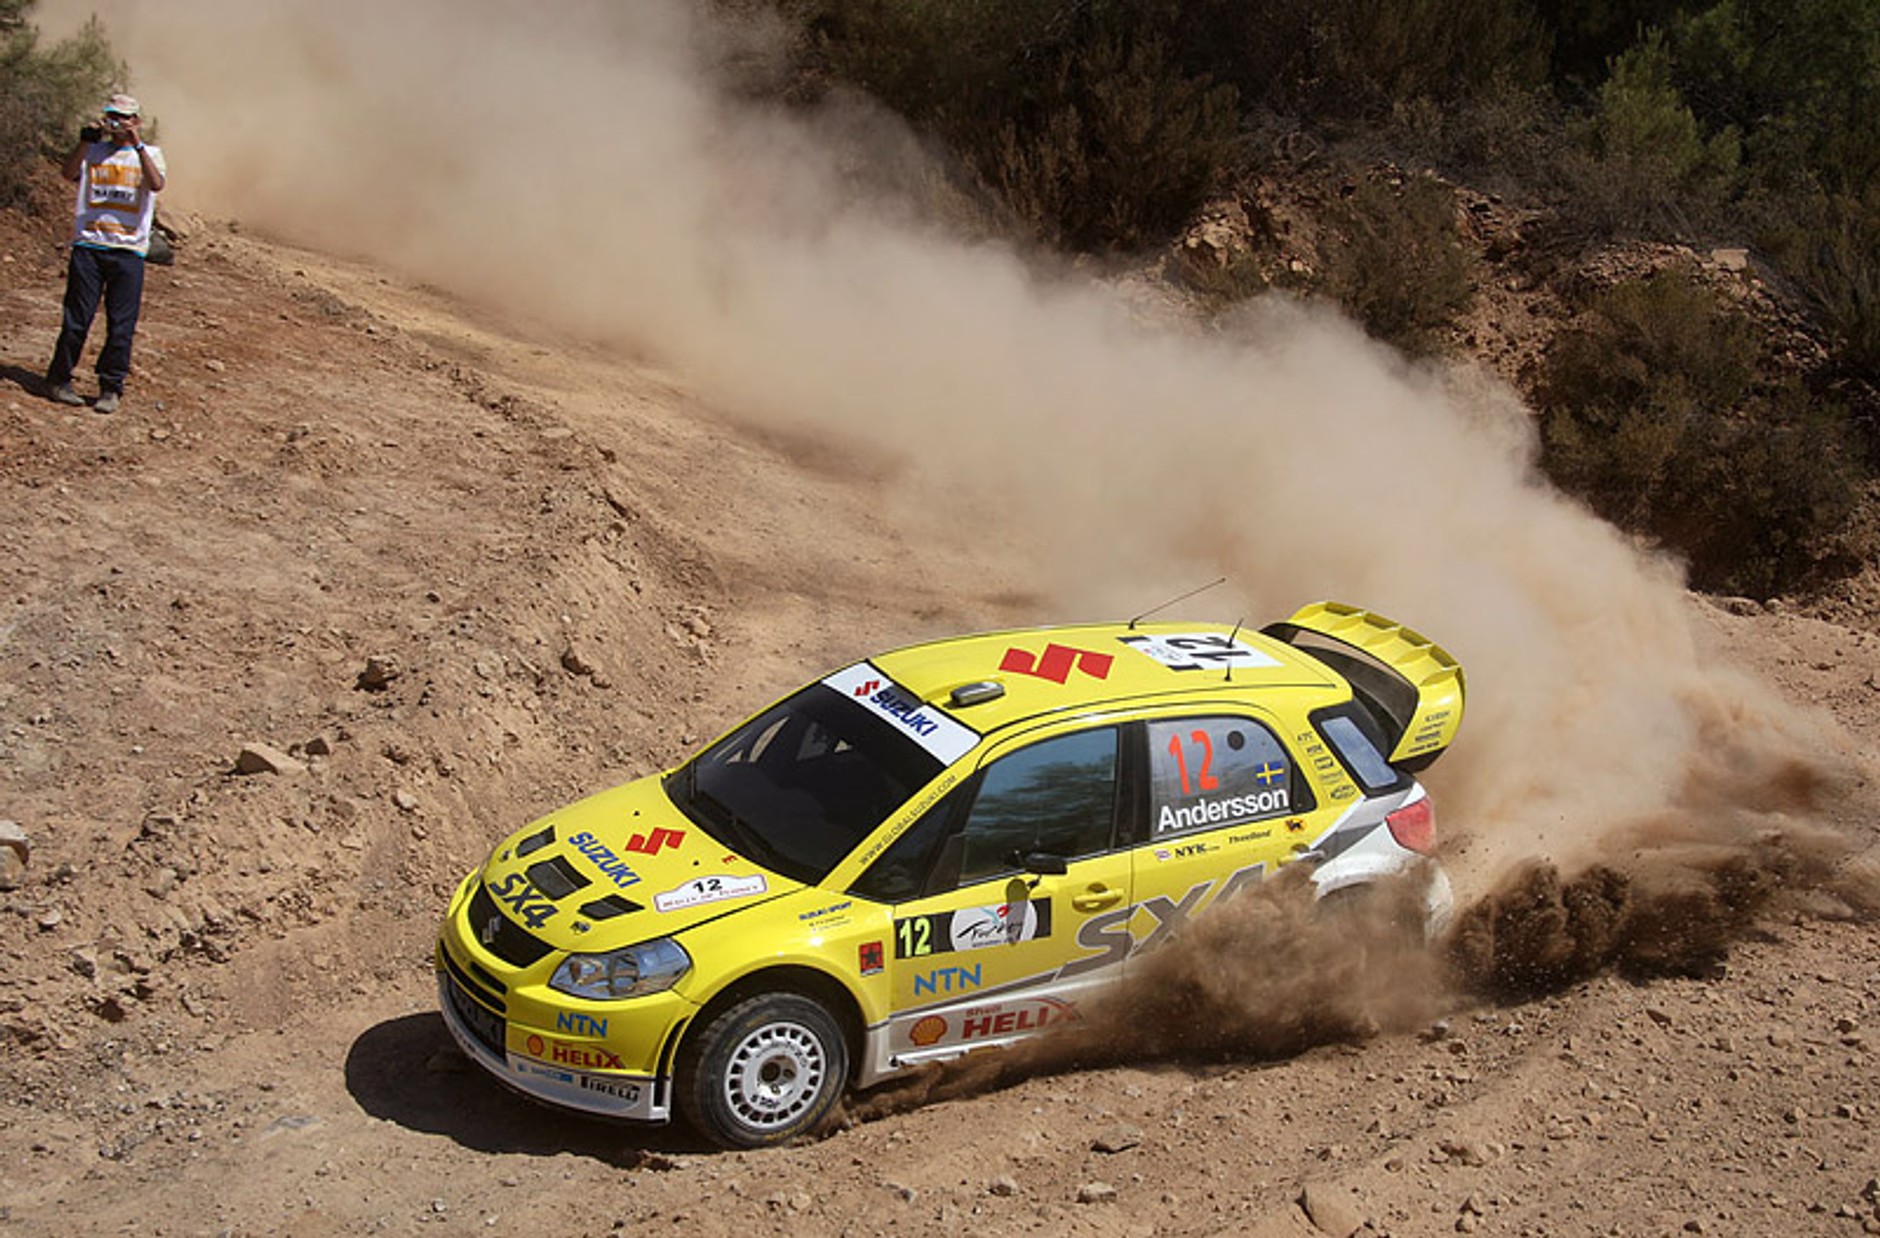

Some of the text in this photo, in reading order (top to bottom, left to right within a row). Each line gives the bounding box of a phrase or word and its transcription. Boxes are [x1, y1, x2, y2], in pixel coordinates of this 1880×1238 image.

[1166, 636, 1251, 661] 12
[870, 688, 939, 737] SUZUKI
[1168, 729, 1219, 795] 12
[1158, 788, 1290, 832] Andersson
[568, 831, 642, 889] SUZUKI
[1175, 843, 1206, 858] NYK
[489, 872, 559, 929] SX4
[693, 878, 723, 893] 12
[900, 917, 931, 957] 12
[914, 964, 981, 996] NTN
[557, 1011, 607, 1038] NTN
[961, 998, 1078, 1039] HELIX
[552, 1046, 623, 1069] HELIX
